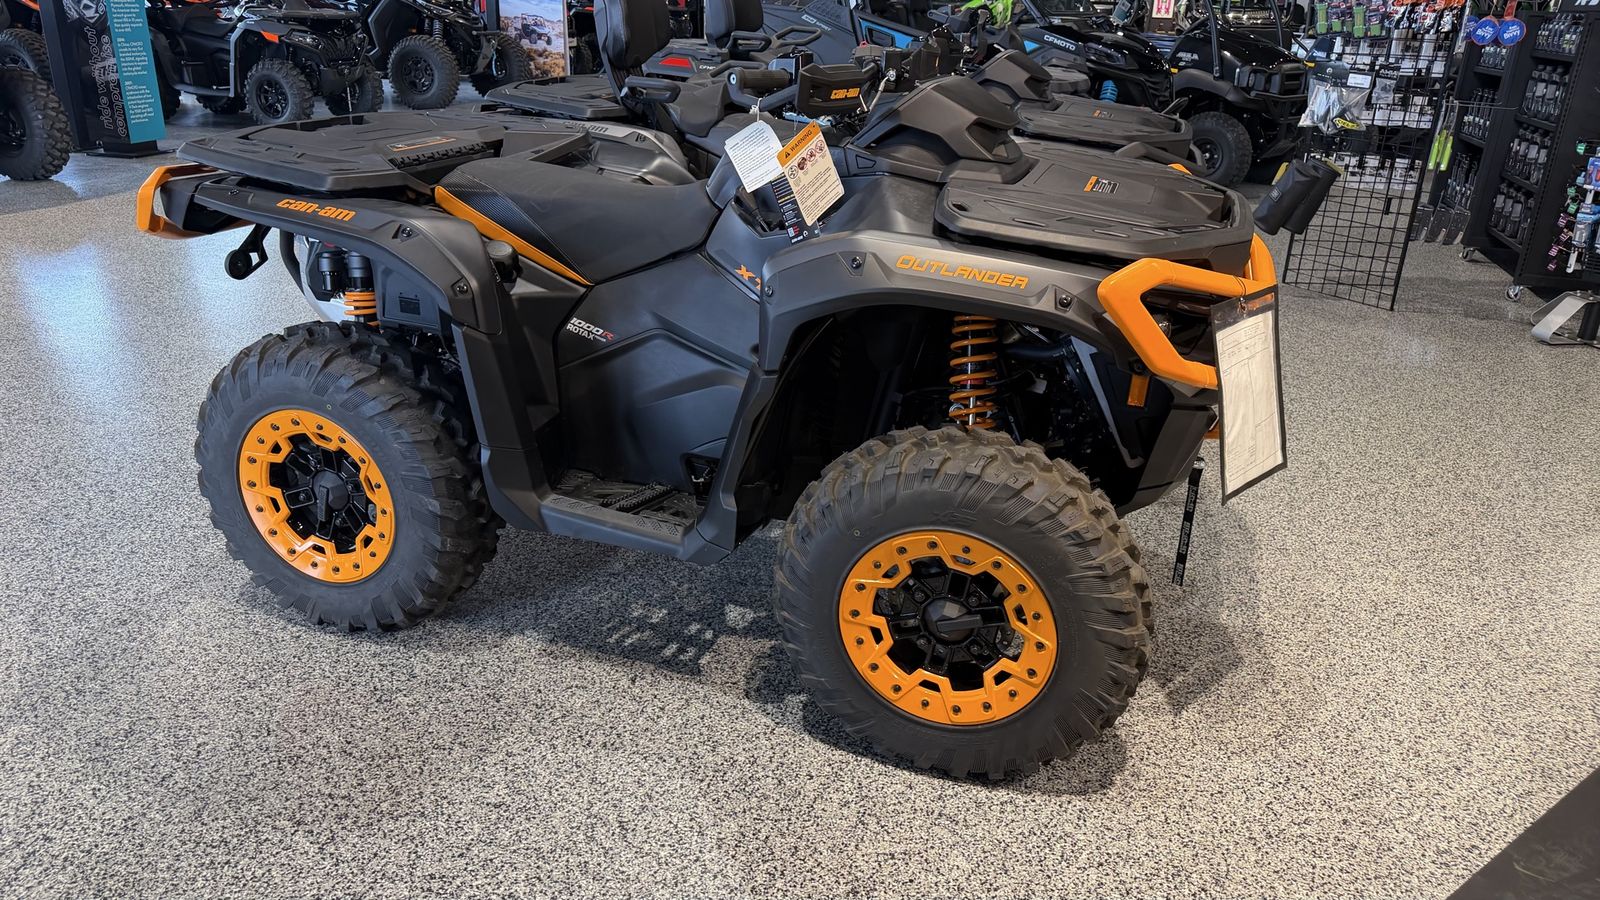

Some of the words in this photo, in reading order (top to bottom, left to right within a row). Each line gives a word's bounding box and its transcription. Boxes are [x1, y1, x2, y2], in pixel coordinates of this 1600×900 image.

[1043, 34, 1076, 51] CFMOTO
[84, 25, 107, 94] without
[100, 34, 127, 137] compromise
[830, 87, 860, 99] can-am
[97, 95, 113, 130] ride
[790, 129, 813, 152] WARNING
[276, 198, 356, 222] can-am
[895, 254, 1029, 289] OUTLANDER
[566, 323, 596, 341] ROTAX
[570, 317, 615, 342] 1000R
